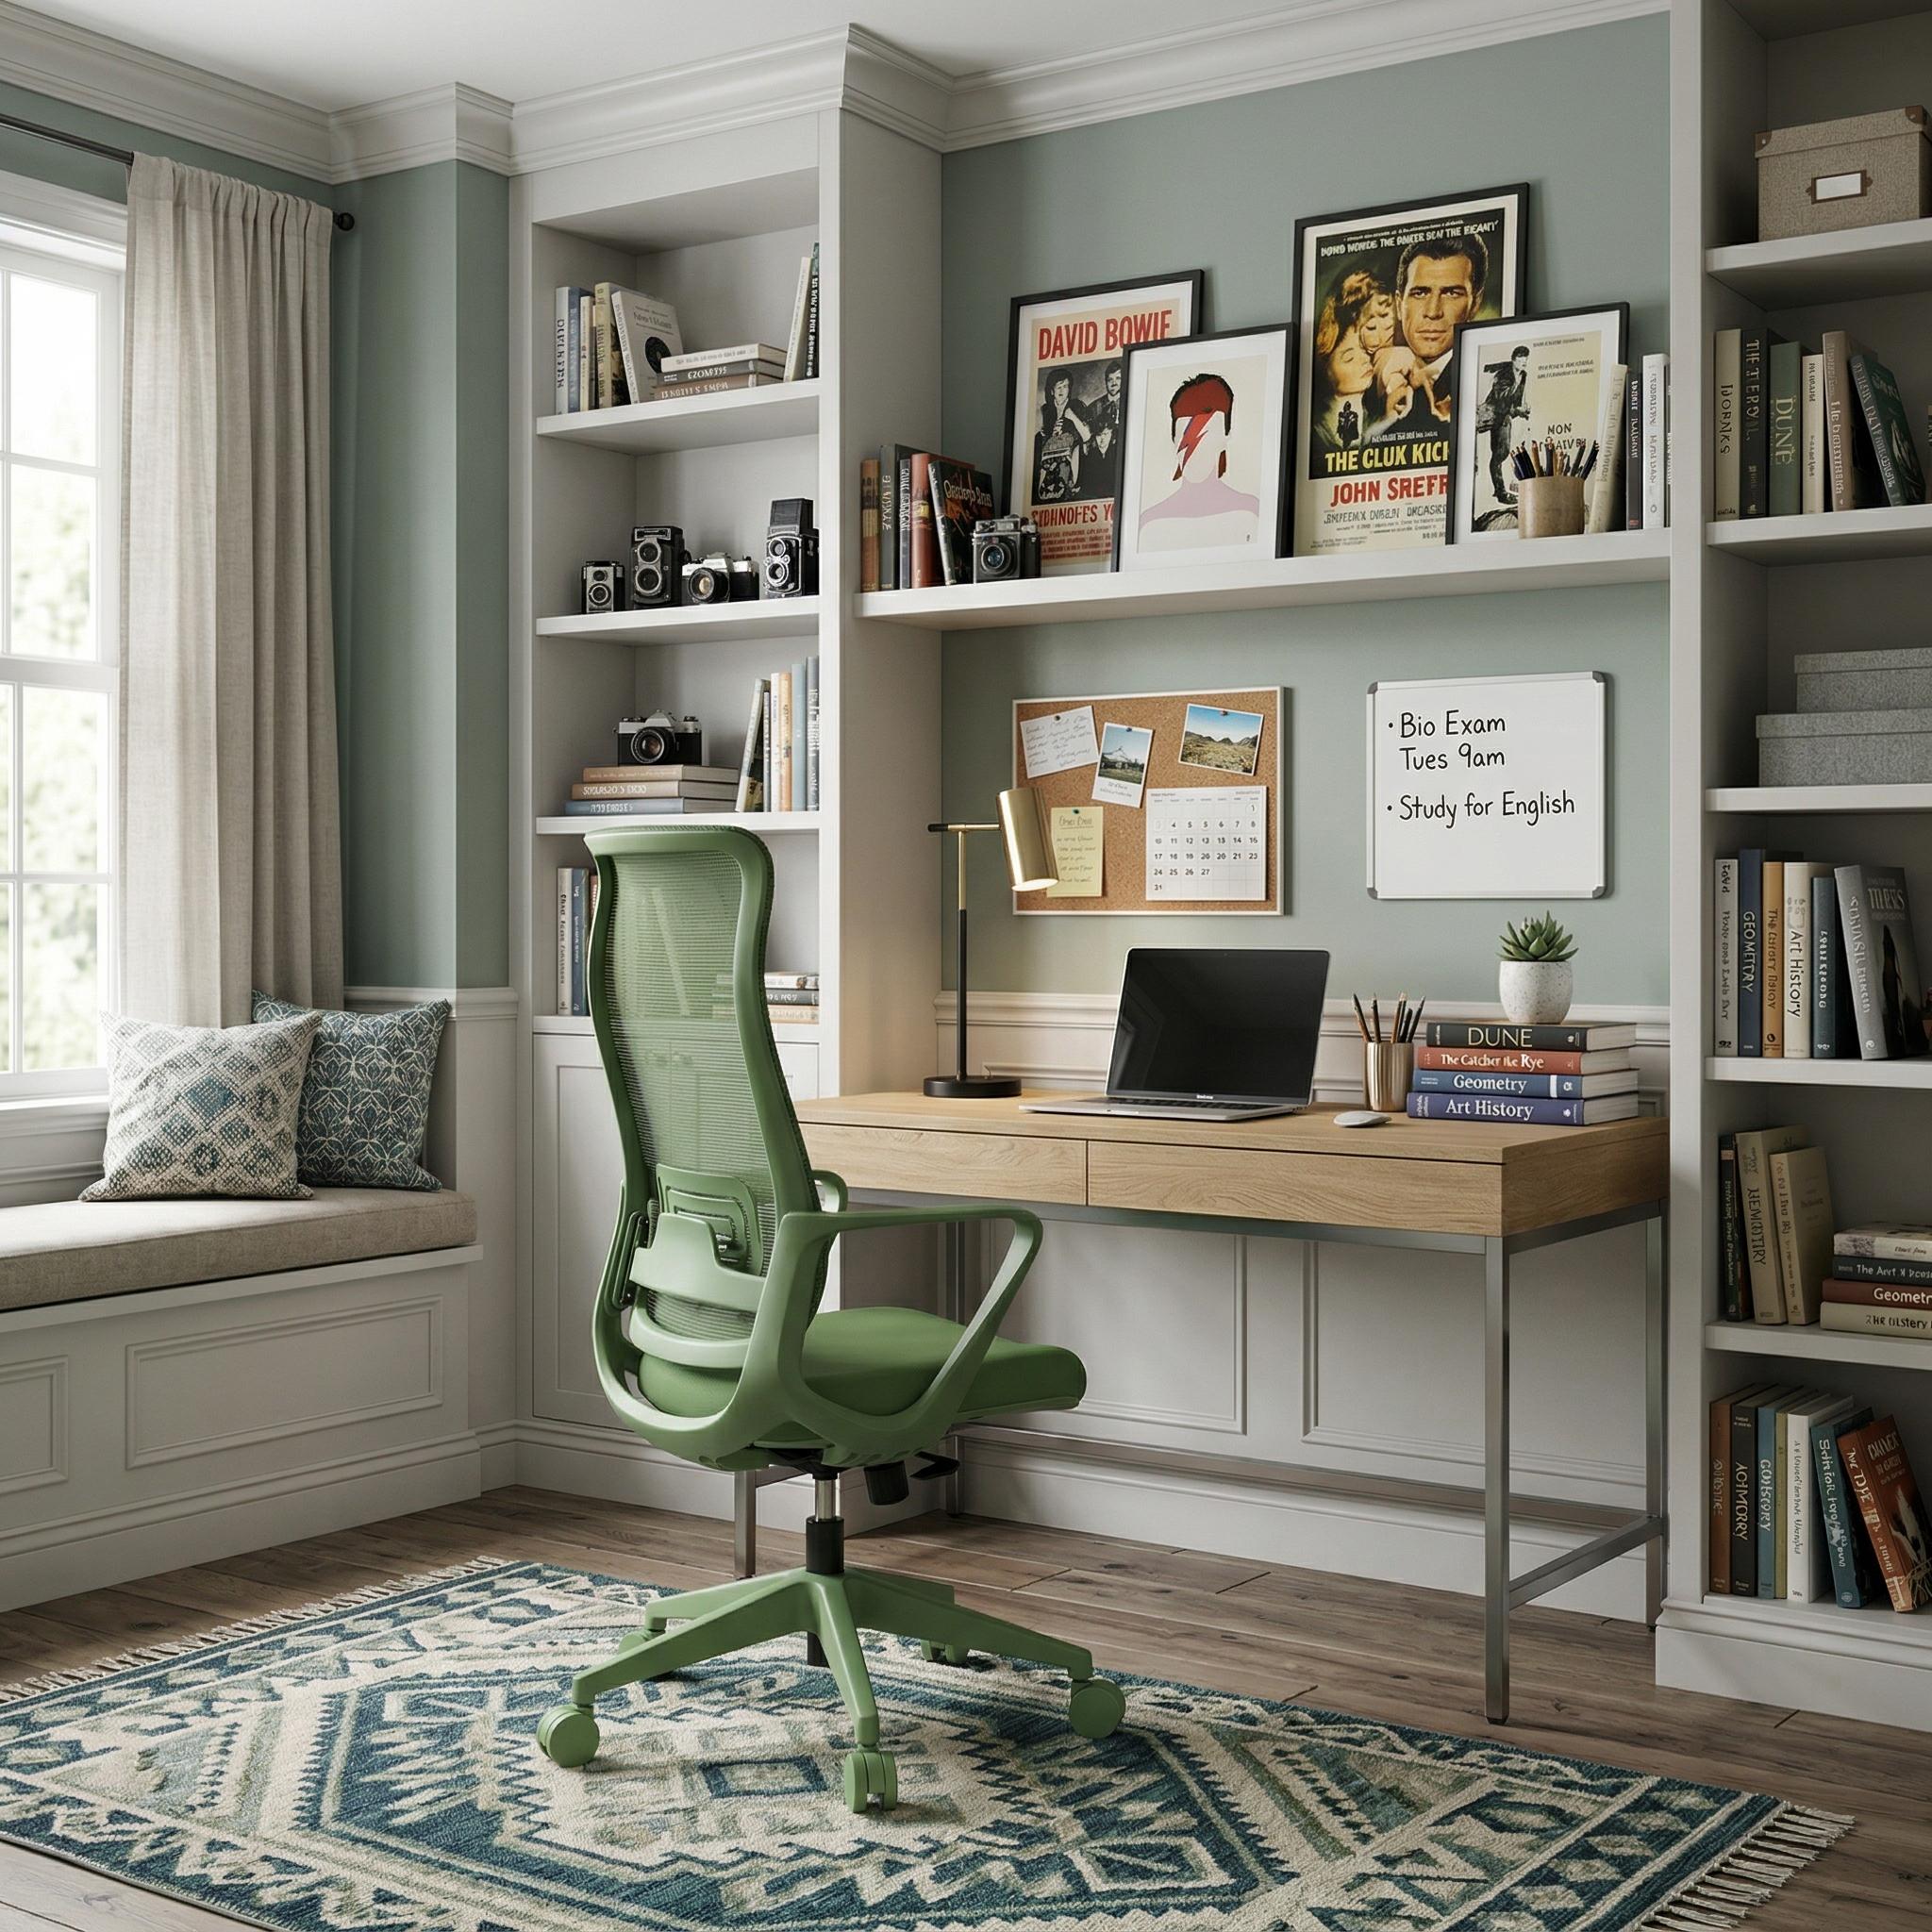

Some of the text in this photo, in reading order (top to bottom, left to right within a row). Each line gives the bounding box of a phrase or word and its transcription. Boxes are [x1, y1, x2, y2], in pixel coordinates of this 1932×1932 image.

[1038, 322, 1098, 360] DAVID
[1324, 450, 1359, 473] THE
[1362, 445, 1407, 469] CLUX
[1330, 480, 1381, 508] JOHN
[1400, 709, 1507, 738] Bio Exam
[1399, 743, 1506, 770] Tues 9am
[1399, 790, 1575, 829] Study for English
[1787, 930, 1805, 1018] Art History
[1467, 1026, 1533, 1048] DUNE
[1441, 1054, 1460, 1066] The
[1520, 1053, 1544, 1073] Rye
[1453, 1074, 1527, 1094] Geometry
[1444, 1099, 1535, 1121] Art History
[1857, 1264, 1874, 1276] The
